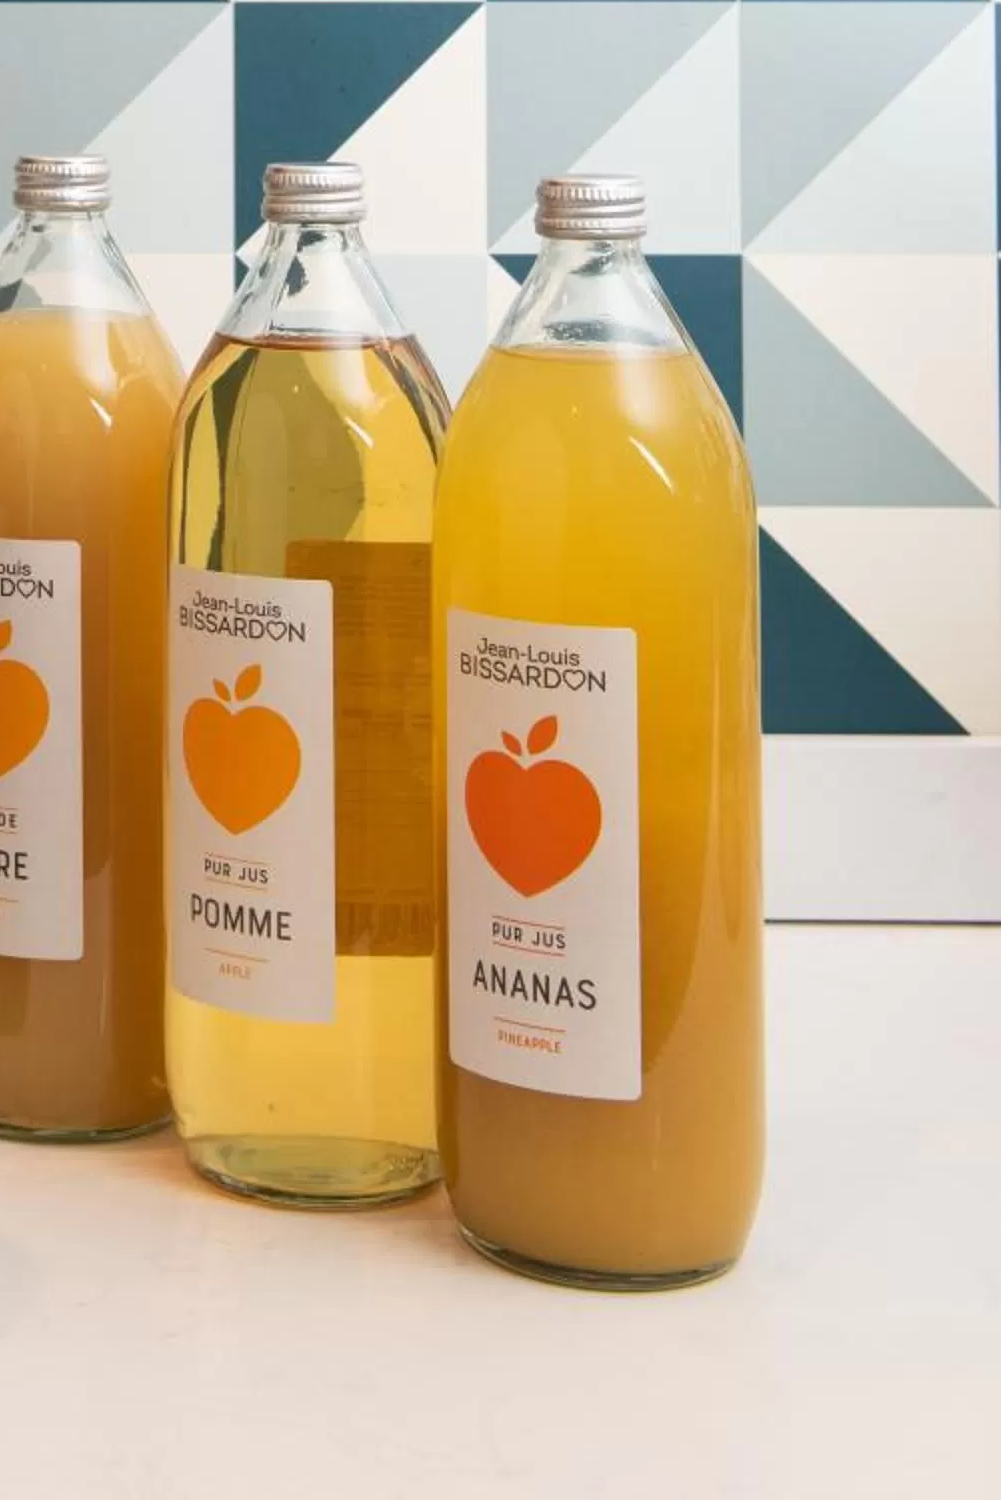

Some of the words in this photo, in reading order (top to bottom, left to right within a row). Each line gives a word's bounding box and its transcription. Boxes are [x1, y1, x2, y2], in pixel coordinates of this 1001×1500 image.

[192, 590, 282, 618] Jean-Louis
[477, 637, 581, 666] Jean-Louis
[204, 858, 231, 877] PUR
[238, 866, 269, 884] JUS
[191, 893, 292, 941] POMME
[492, 922, 522, 942] PUR
[532, 931, 567, 950] JUS
[472, 959, 598, 1012] ANANAS
[497, 1029, 562, 1055] PINEAPPLE
